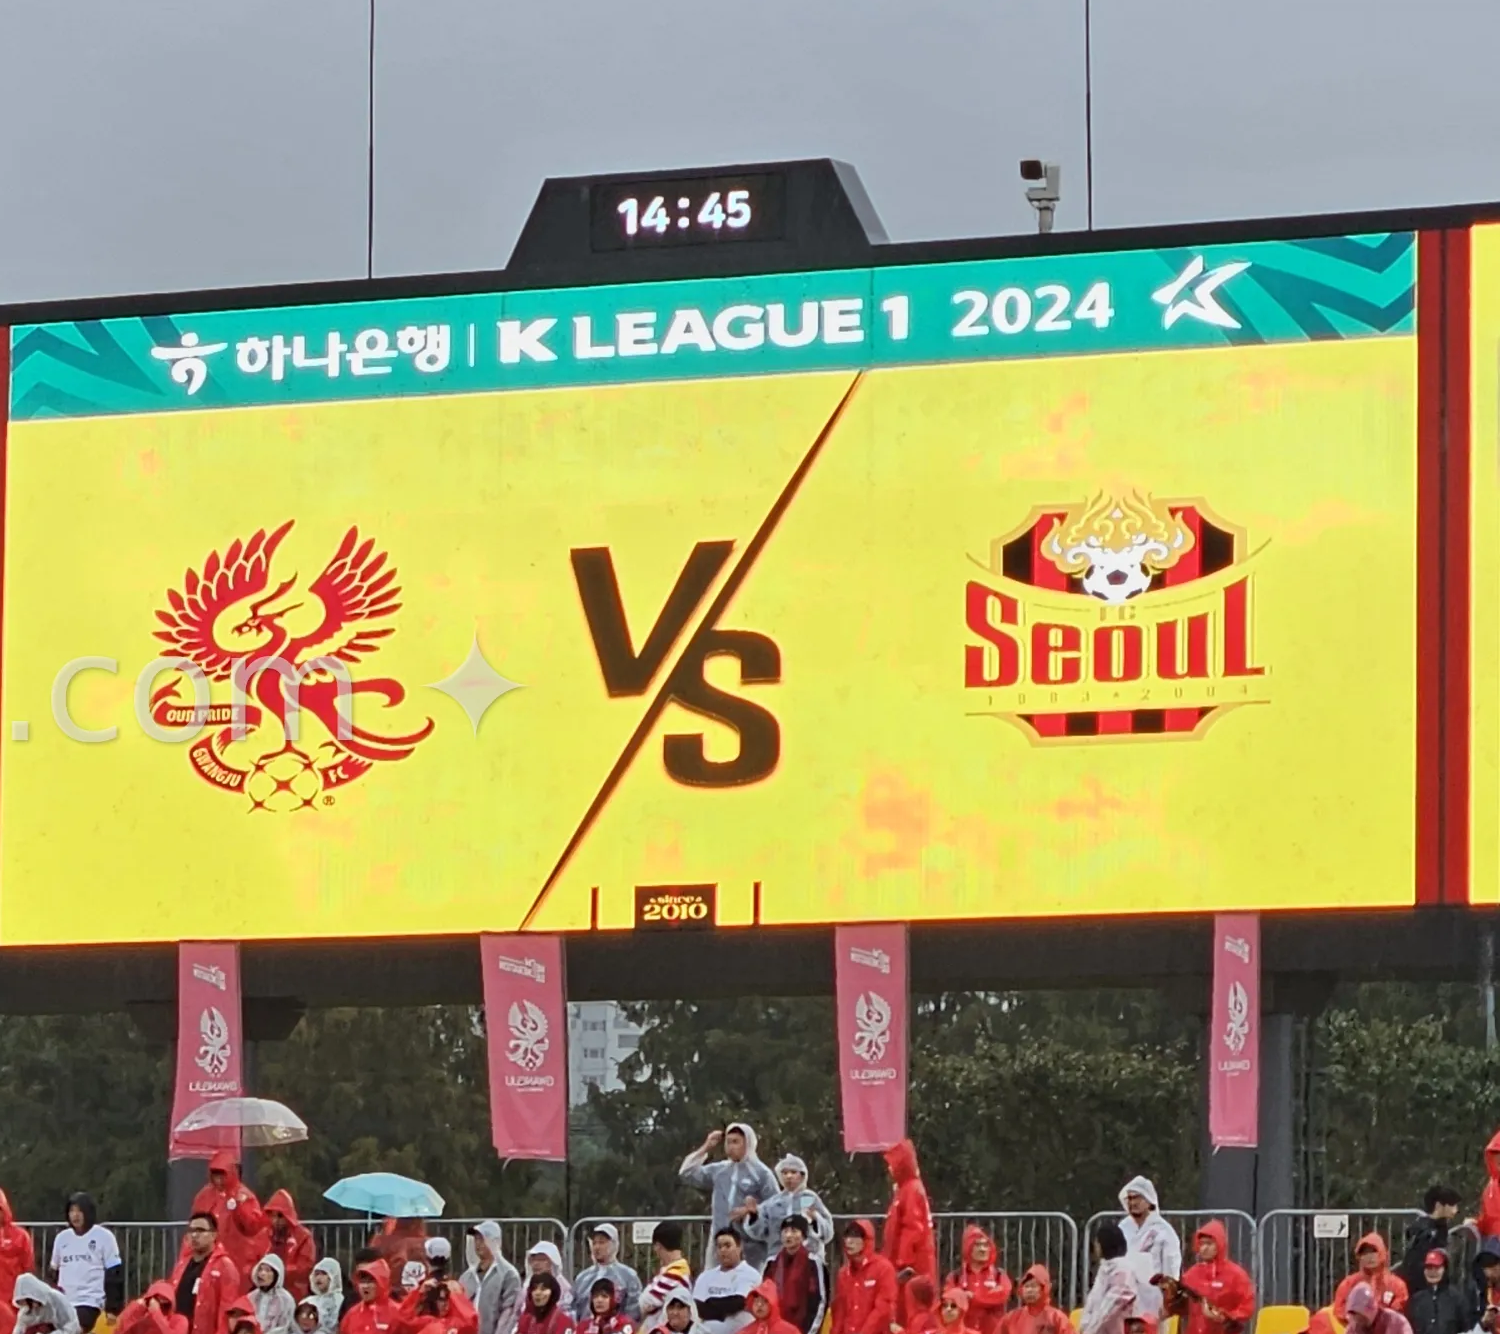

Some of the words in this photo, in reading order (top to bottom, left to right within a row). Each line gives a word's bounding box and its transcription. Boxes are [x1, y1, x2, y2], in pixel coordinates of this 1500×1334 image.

[618, 190, 751, 235] 14:45
[496, 318, 558, 364] K
[574, 298, 864, 359] LEAGUE
[881, 295, 910, 340] 1
[952, 282, 1114, 337] 2024
[236, 324, 450, 381] 하나은행
[570, 539, 781, 789] VS
[166, 709, 196, 723] OUR
[197, 707, 240, 721] PRIDE
[192, 747, 242, 787] GWANGJU
[328, 767, 349, 783] FC
[643, 903, 708, 921] 2010
